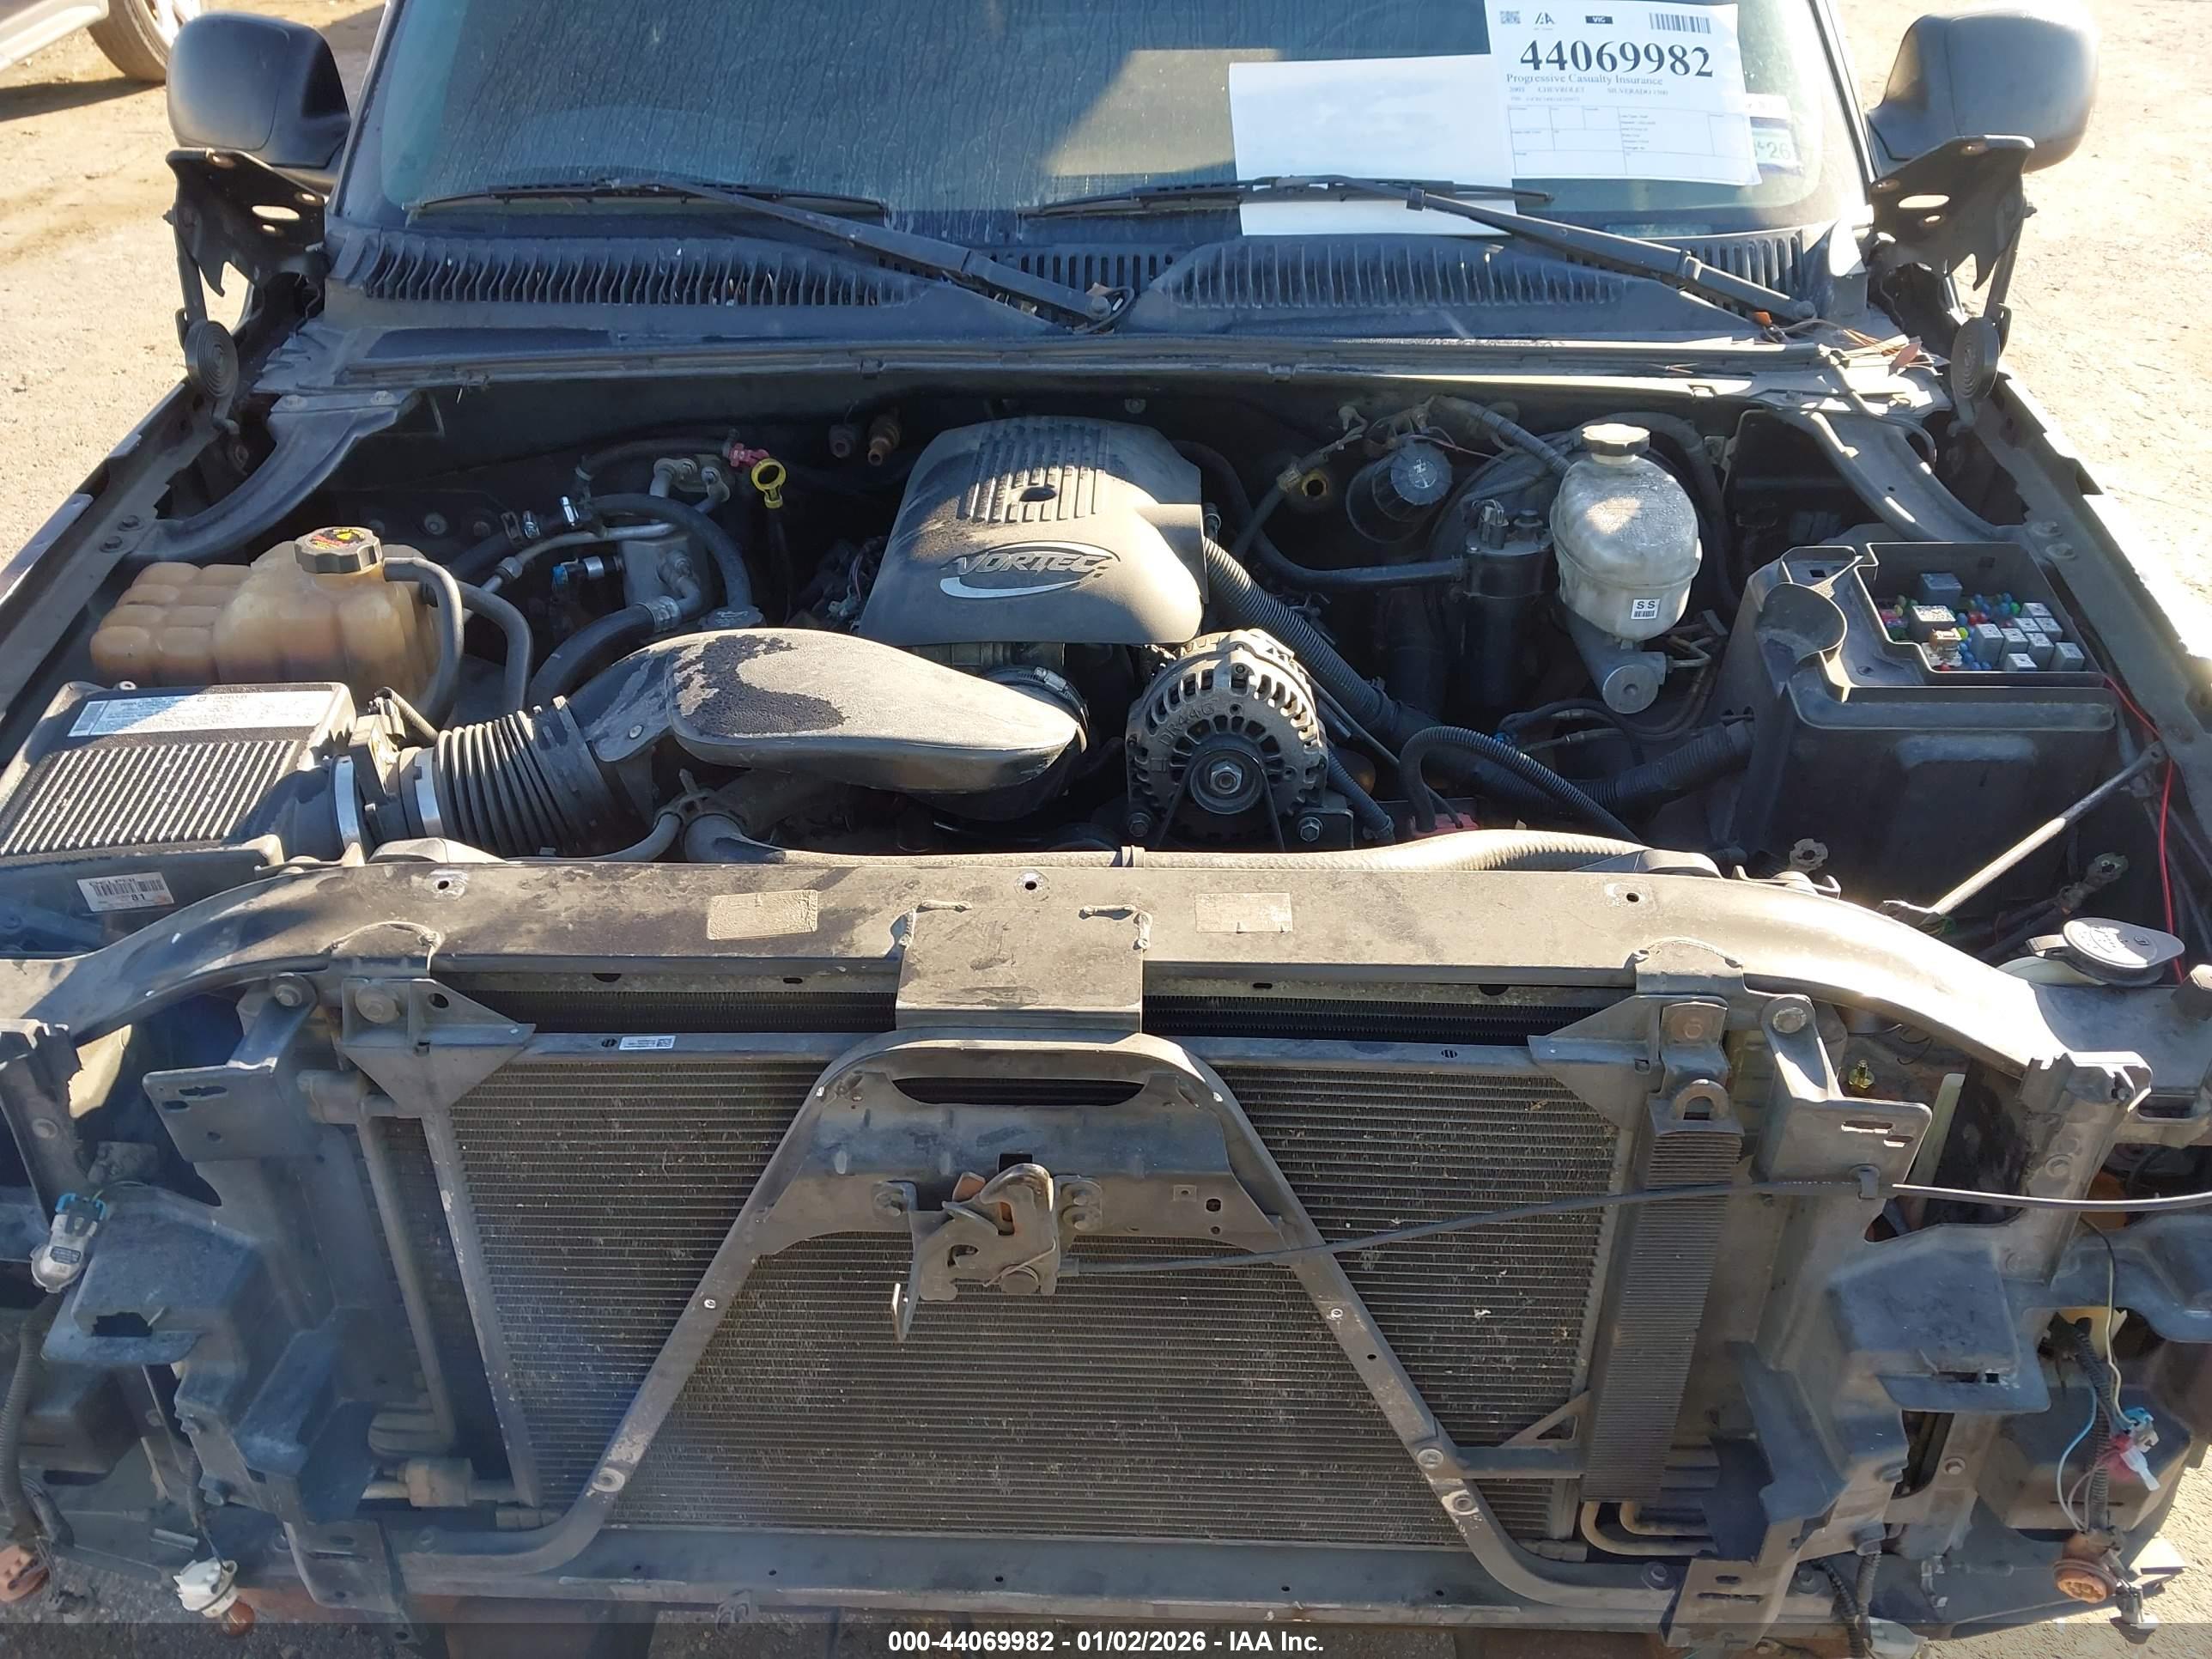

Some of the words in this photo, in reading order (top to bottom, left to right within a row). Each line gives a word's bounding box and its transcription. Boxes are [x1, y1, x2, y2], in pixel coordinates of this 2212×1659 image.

[1520, 40, 1713, 77] 44069982
[1507, 74, 1566, 84] Progressive
[1569, 74, 1612, 86] Casualty
[1616, 75, 1663, 86] Insurance
[956, 551, 1113, 575] VORTEC
